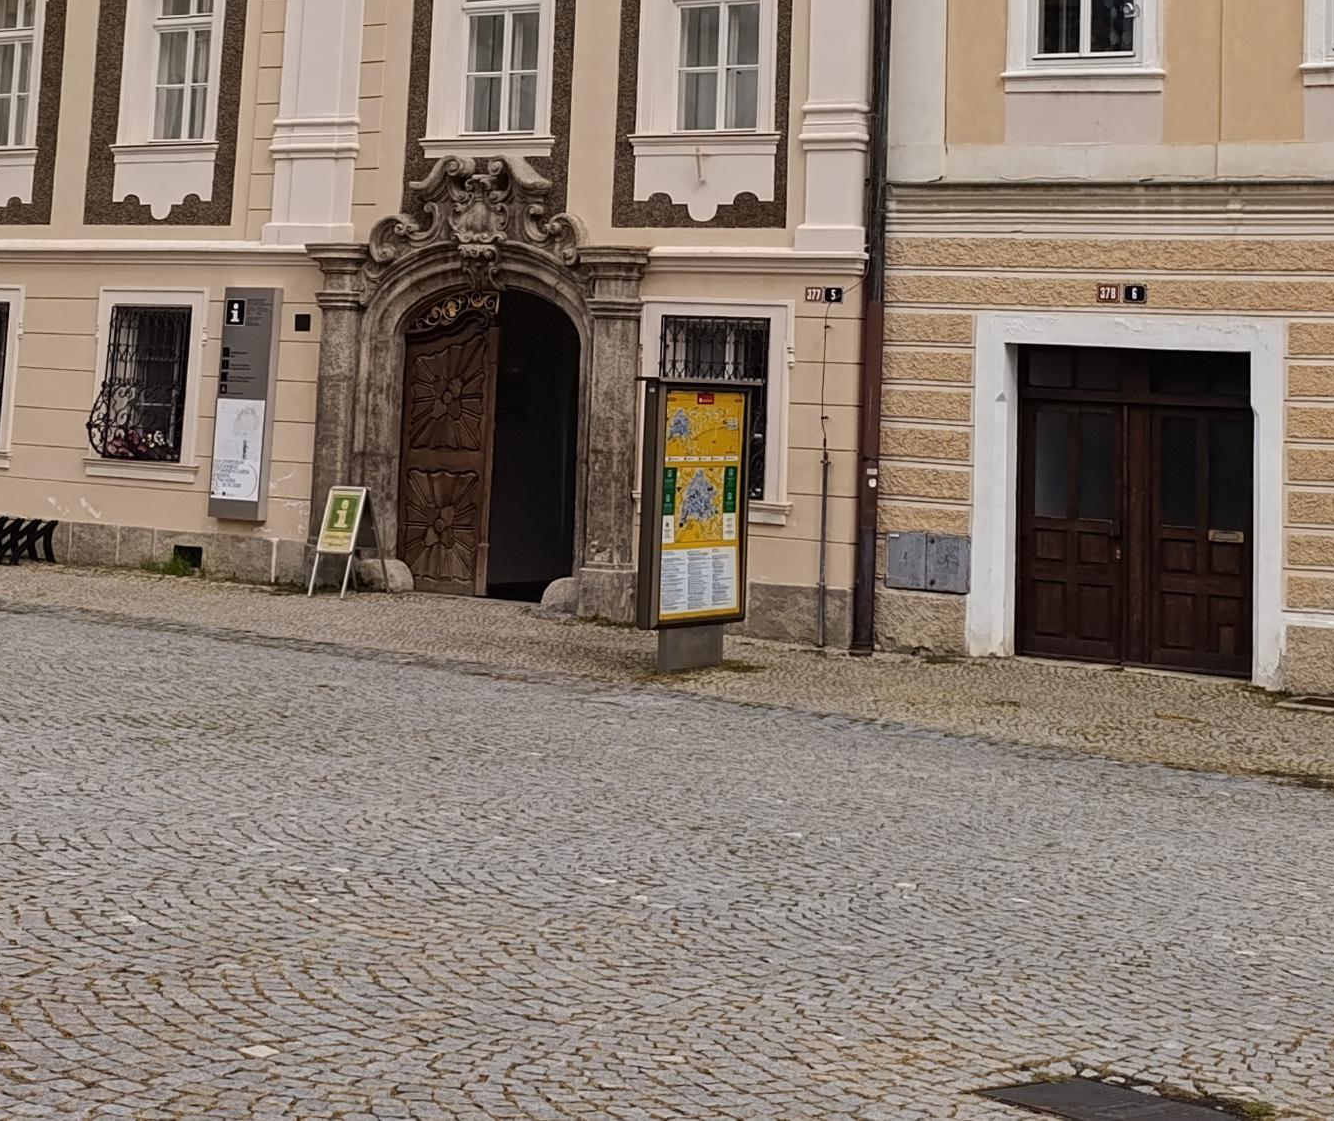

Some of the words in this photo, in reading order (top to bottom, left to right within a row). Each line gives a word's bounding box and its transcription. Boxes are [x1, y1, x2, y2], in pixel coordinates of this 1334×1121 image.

[807, 288, 821, 300] 377
[830, 288, 836, 300] 5
[1100, 287, 1116, 299] 378
[1131, 287, 1138, 299] 6
